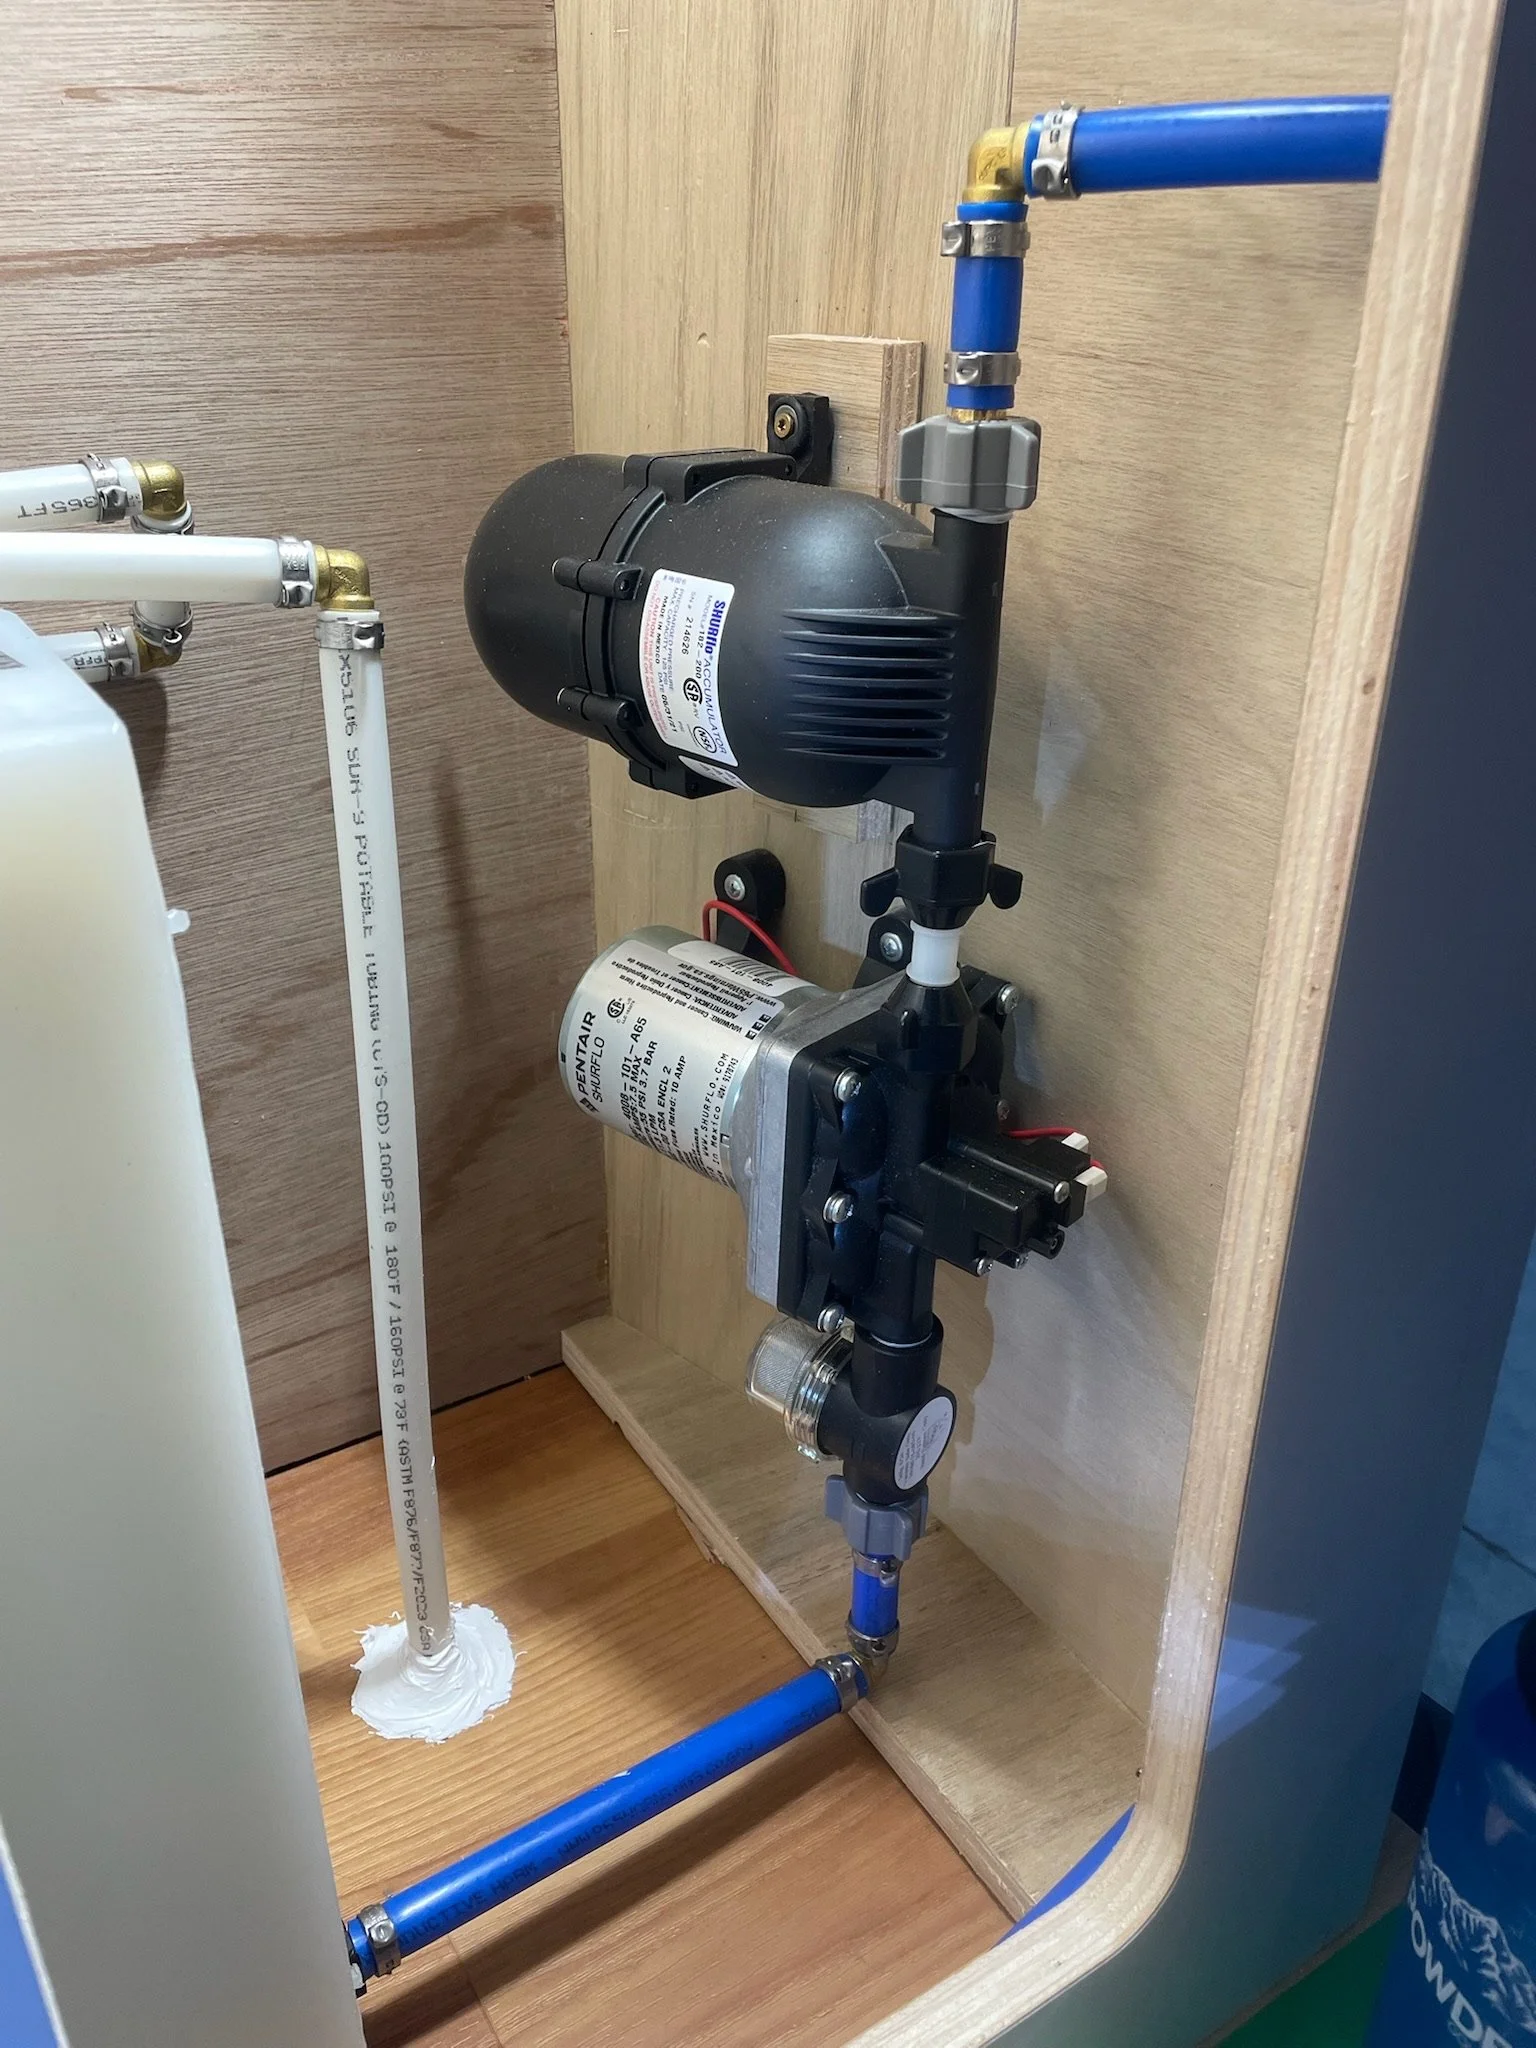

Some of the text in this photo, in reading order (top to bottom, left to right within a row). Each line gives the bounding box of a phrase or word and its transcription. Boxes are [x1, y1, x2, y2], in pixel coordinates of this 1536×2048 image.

[650, 597, 661, 637] CAUTION
[657, 621, 663, 631] IN
[660, 596, 668, 618] MADE
[682, 617, 694, 655] 214626
[703, 658, 727, 754] ACCUMULATOR
[619, 974, 743, 1034] WARNING: Cancer and Reproductive Harm
[670, 987, 692, 1000] Cancer
[576, 1011, 596, 1095] PENTAIR
[590, 1036, 605, 1102] SHURFLO
[630, 1055, 643, 1083] MAX
[674, 1055, 686, 1080] AMP
[638, 1041, 658, 1109] PSI 3.7 BAR
[670, 1081, 679, 1093] 10
[657, 1065, 672, 1131] CSA ENCL 2
[648, 1113, 659, 1136] LPM
[711, 1106, 721, 1148] Mexico
[378, 1141, 397, 1214] 100PSI
[384, 1220, 398, 1233] @
[388, 1300, 401, 1309] /
[389, 1315, 405, 1379] 160PSI
[393, 1384, 405, 1394] @
